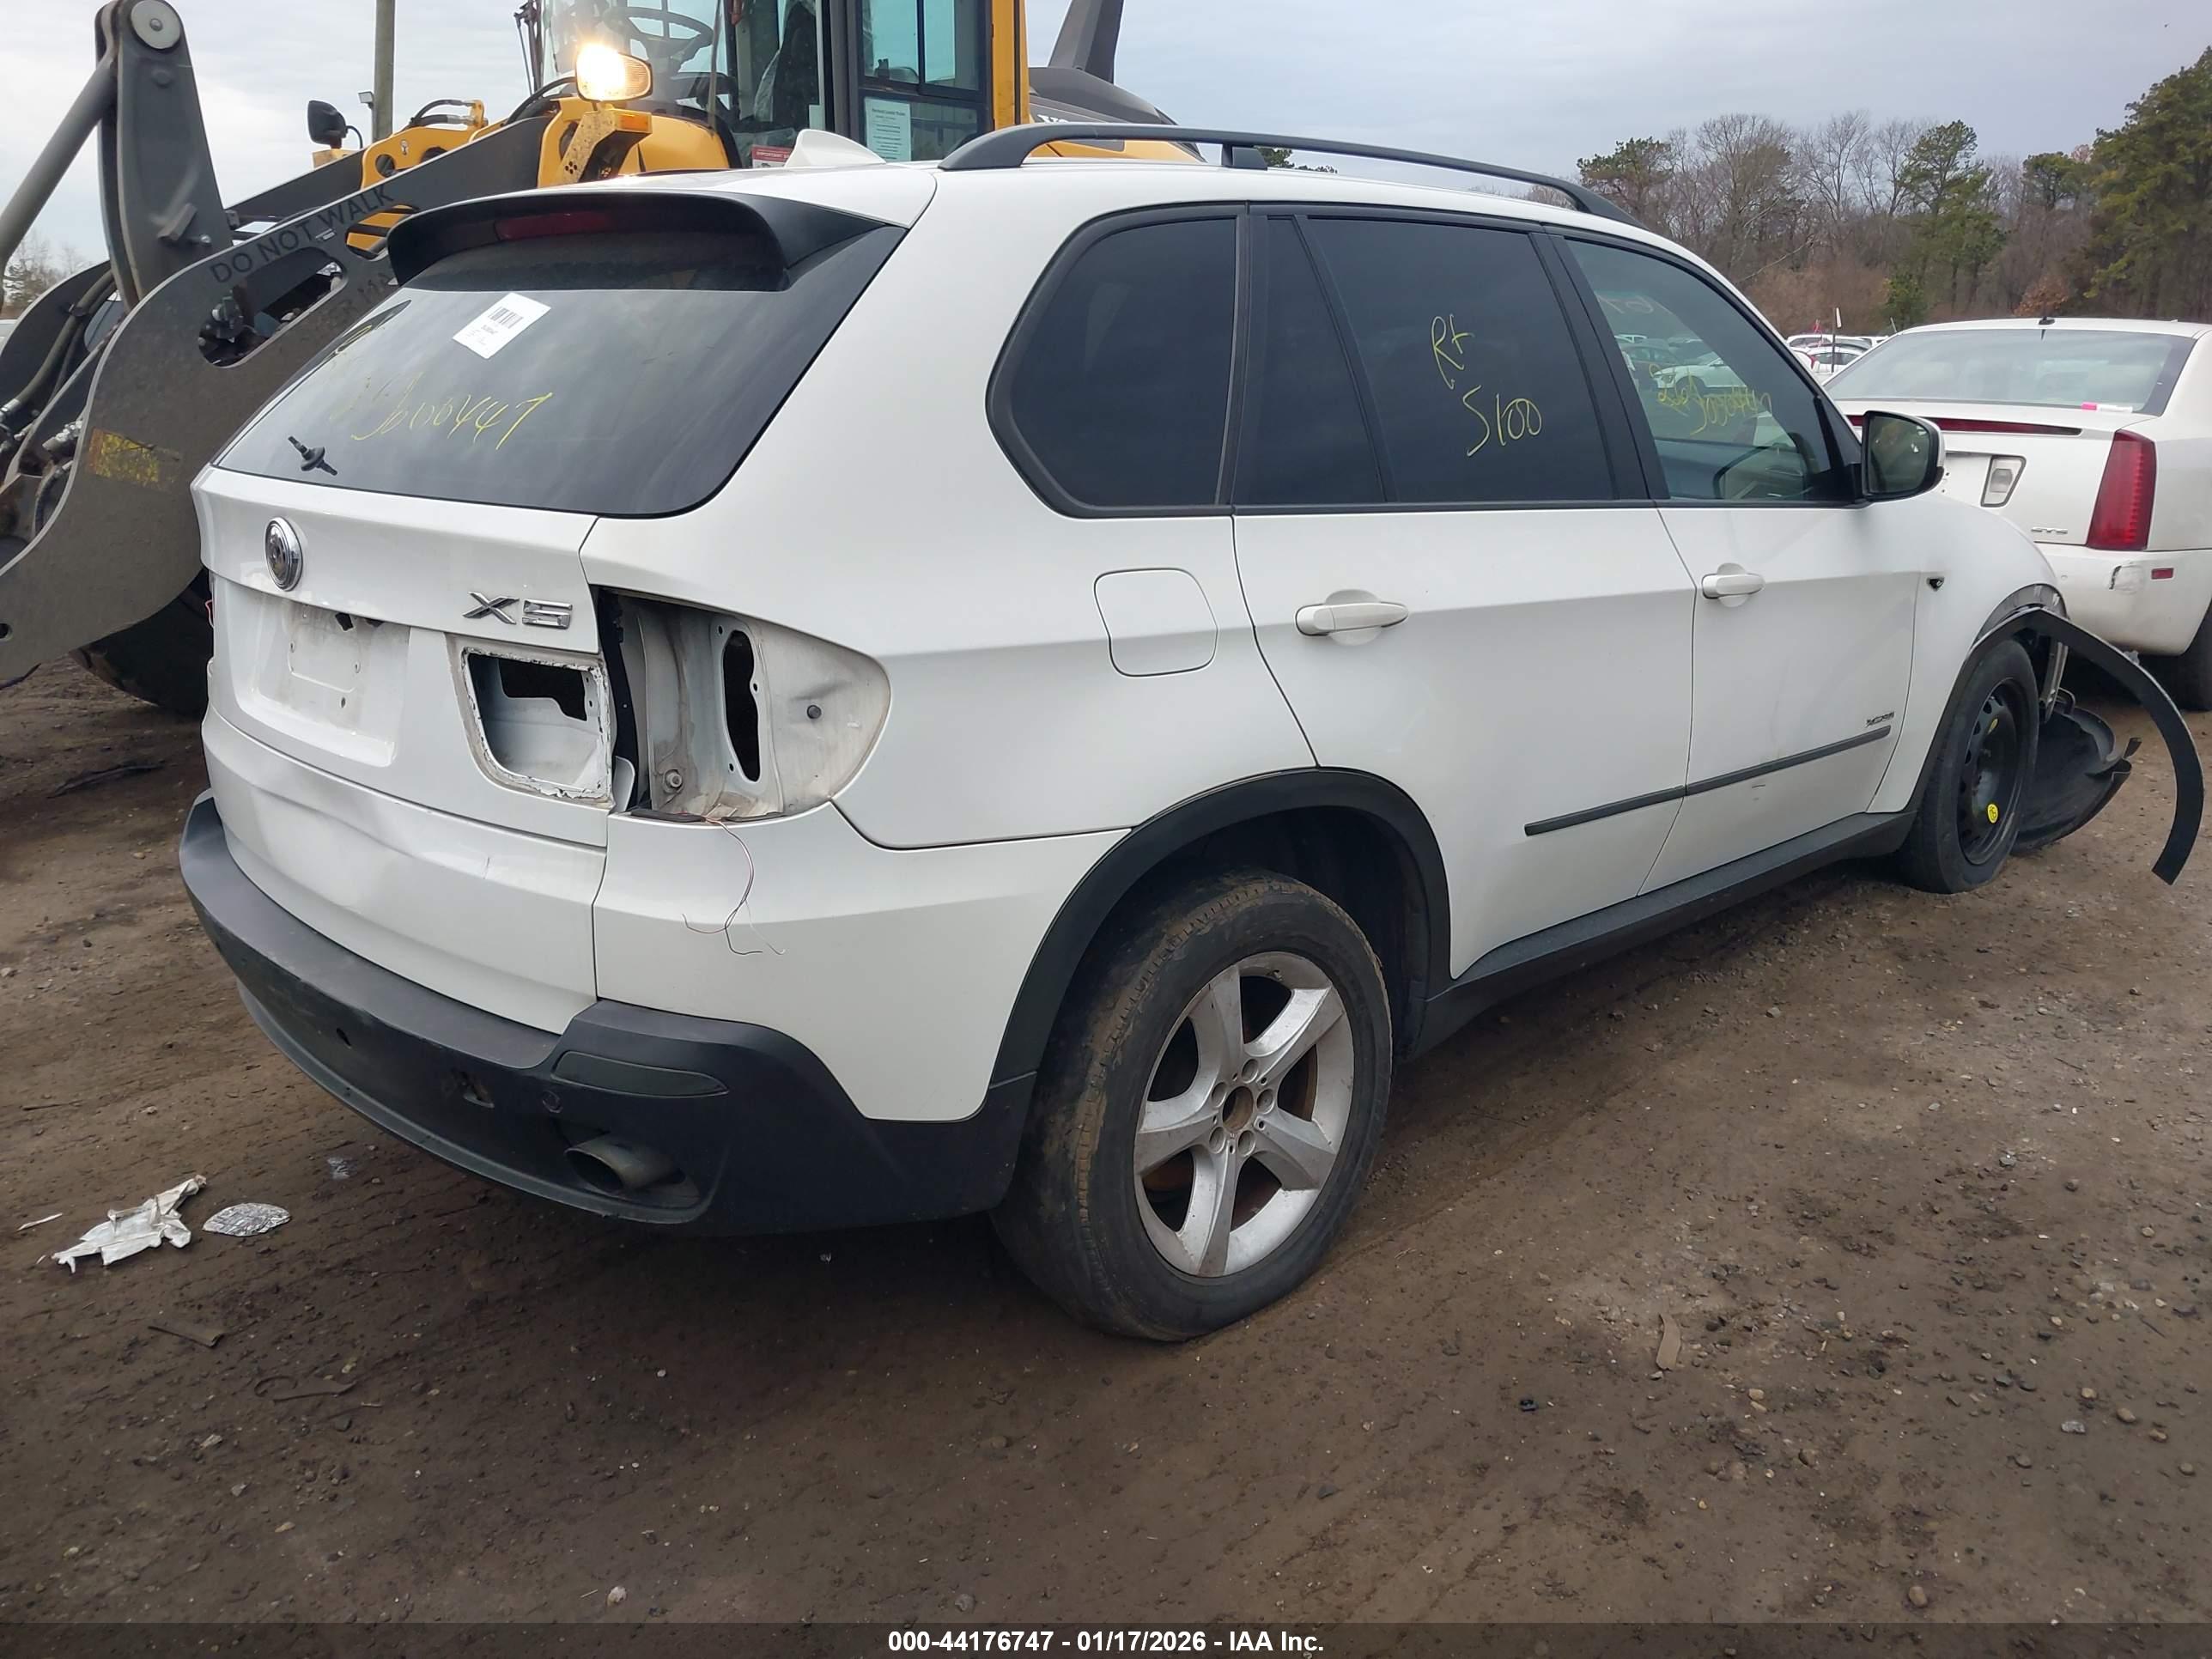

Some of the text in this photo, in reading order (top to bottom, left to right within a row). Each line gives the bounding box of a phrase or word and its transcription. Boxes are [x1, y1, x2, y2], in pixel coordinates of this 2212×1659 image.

[210, 185, 394, 283] DO NOT WALK
[462, 591, 573, 629] X5
